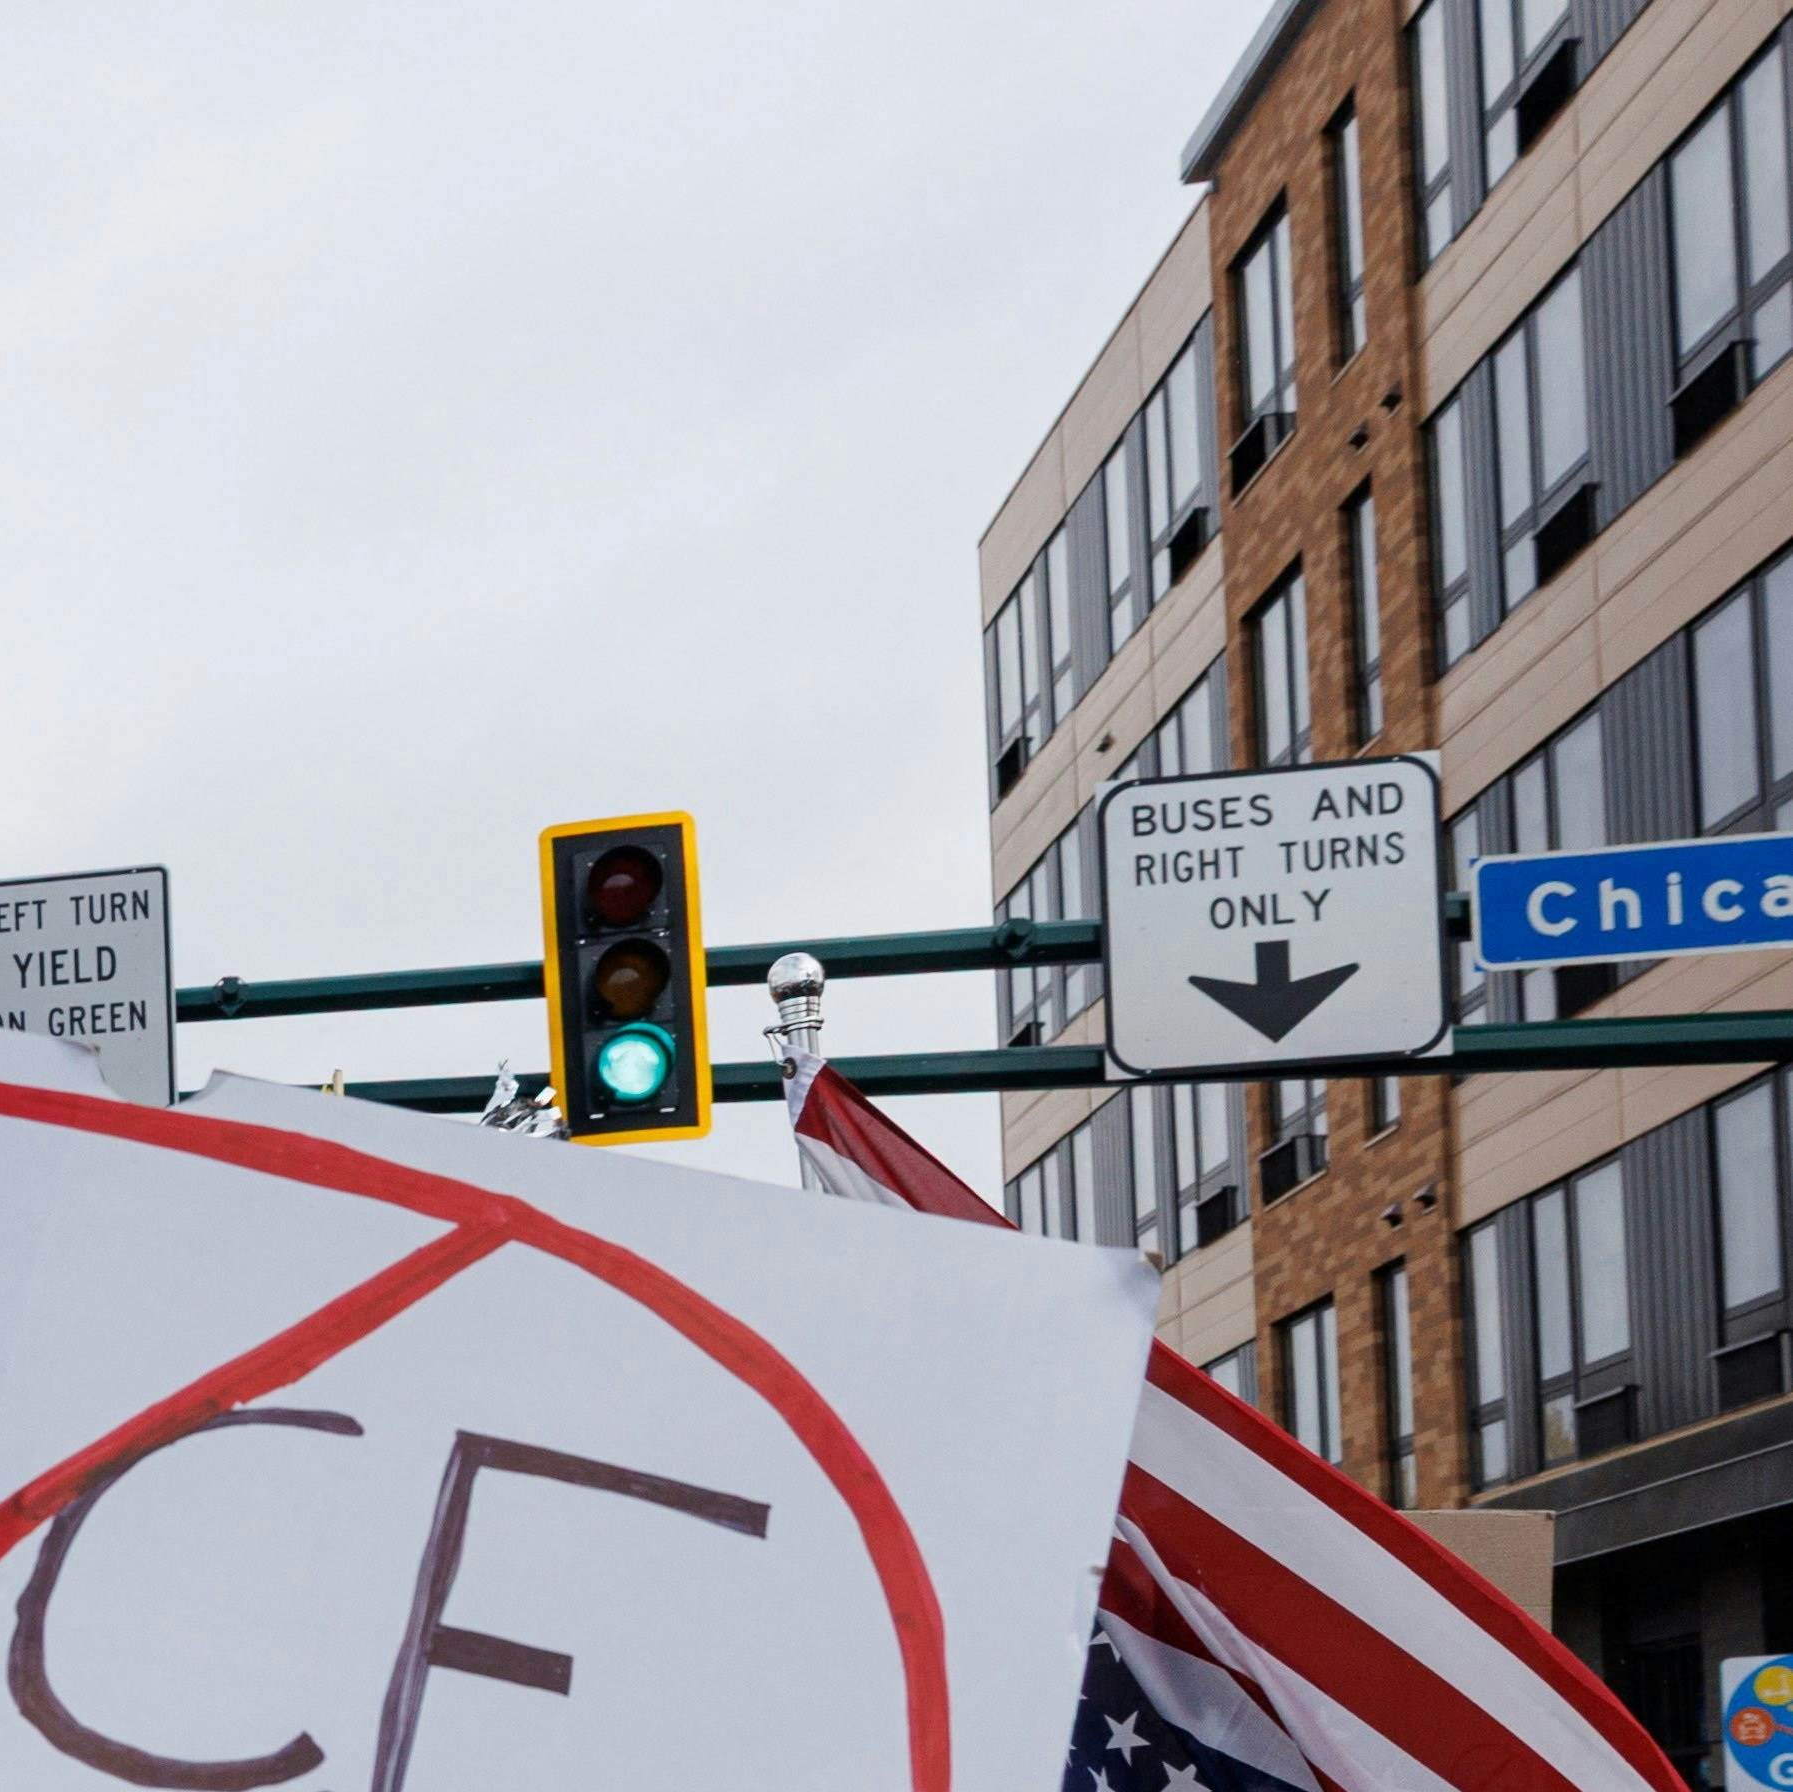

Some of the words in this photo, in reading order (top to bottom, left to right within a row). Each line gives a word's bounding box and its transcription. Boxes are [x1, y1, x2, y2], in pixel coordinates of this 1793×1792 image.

[1131, 795, 1274, 837] BUSES
[1312, 782, 1404, 825] AND
[1134, 846, 1244, 886] RIGHT
[1279, 833, 1406, 872] TURNS
[70, 889, 150, 926] TURN
[1209, 888, 1332, 930] ONLY
[13, 946, 117, 989] YIELD
[48, 1000, 147, 1037] GREEN
